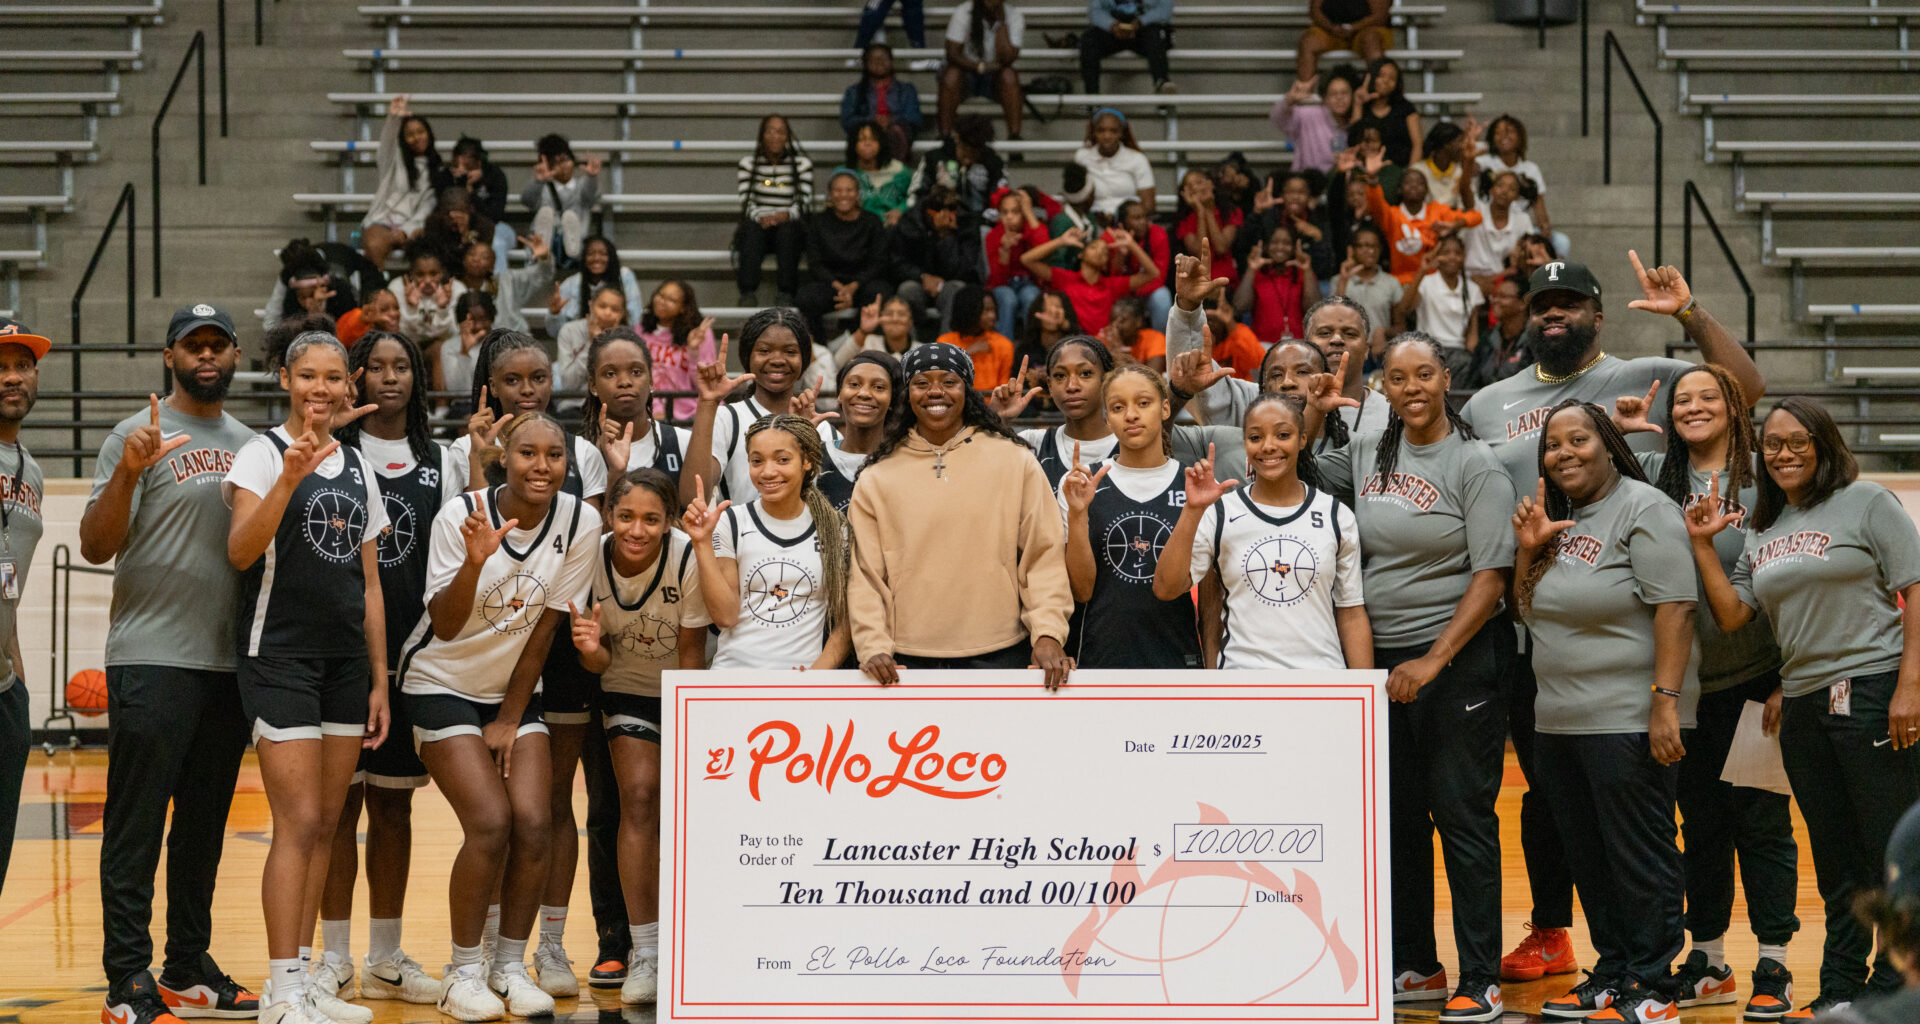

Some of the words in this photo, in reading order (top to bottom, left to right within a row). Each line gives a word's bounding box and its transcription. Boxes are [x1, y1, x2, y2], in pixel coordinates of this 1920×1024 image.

[1545, 261, 1565, 281] T
[168, 447, 236, 485] LANCAS
[666, 453, 679, 471] 0
[349, 467, 363, 485] 3
[418, 466, 439, 488] 33
[1167, 490, 1187, 507] 12
[553, 534, 563, 554] 4
[1558, 529, 1603, 566] ASTER
[1747, 531, 1831, 574] LANCASTER
[661, 586, 680, 604] 15
[1124, 740, 1155, 753] Date
[1170, 734, 1263, 749] 11/20/2025
[704, 747, 735, 780] El
[747, 718, 871, 801] Pollo
[866, 725, 1007, 799] Loco
[740, 834, 763, 848] Pay
[766, 836, 779, 847] to
[783, 834, 804, 847] the
[822, 837, 961, 861] Lancaster
[967, 836, 1038, 869] High
[1046, 836, 1137, 861] School
[1180, 829, 1317, 854] 10,000.00
[740, 853, 778, 866] Order
[781, 853, 796, 866] of
[779, 881, 824, 904] Ten
[835, 880, 972, 904] Thousand
[979, 880, 1033, 904] and
[1041, 880, 1137, 907] 00/100
[1255, 890, 1304, 903] Dollars
[757, 957, 792, 970] From
[846, 945, 910, 971] Pollo
[919, 946, 970, 973] Loco
[981, 946, 1117, 971] Foundation
